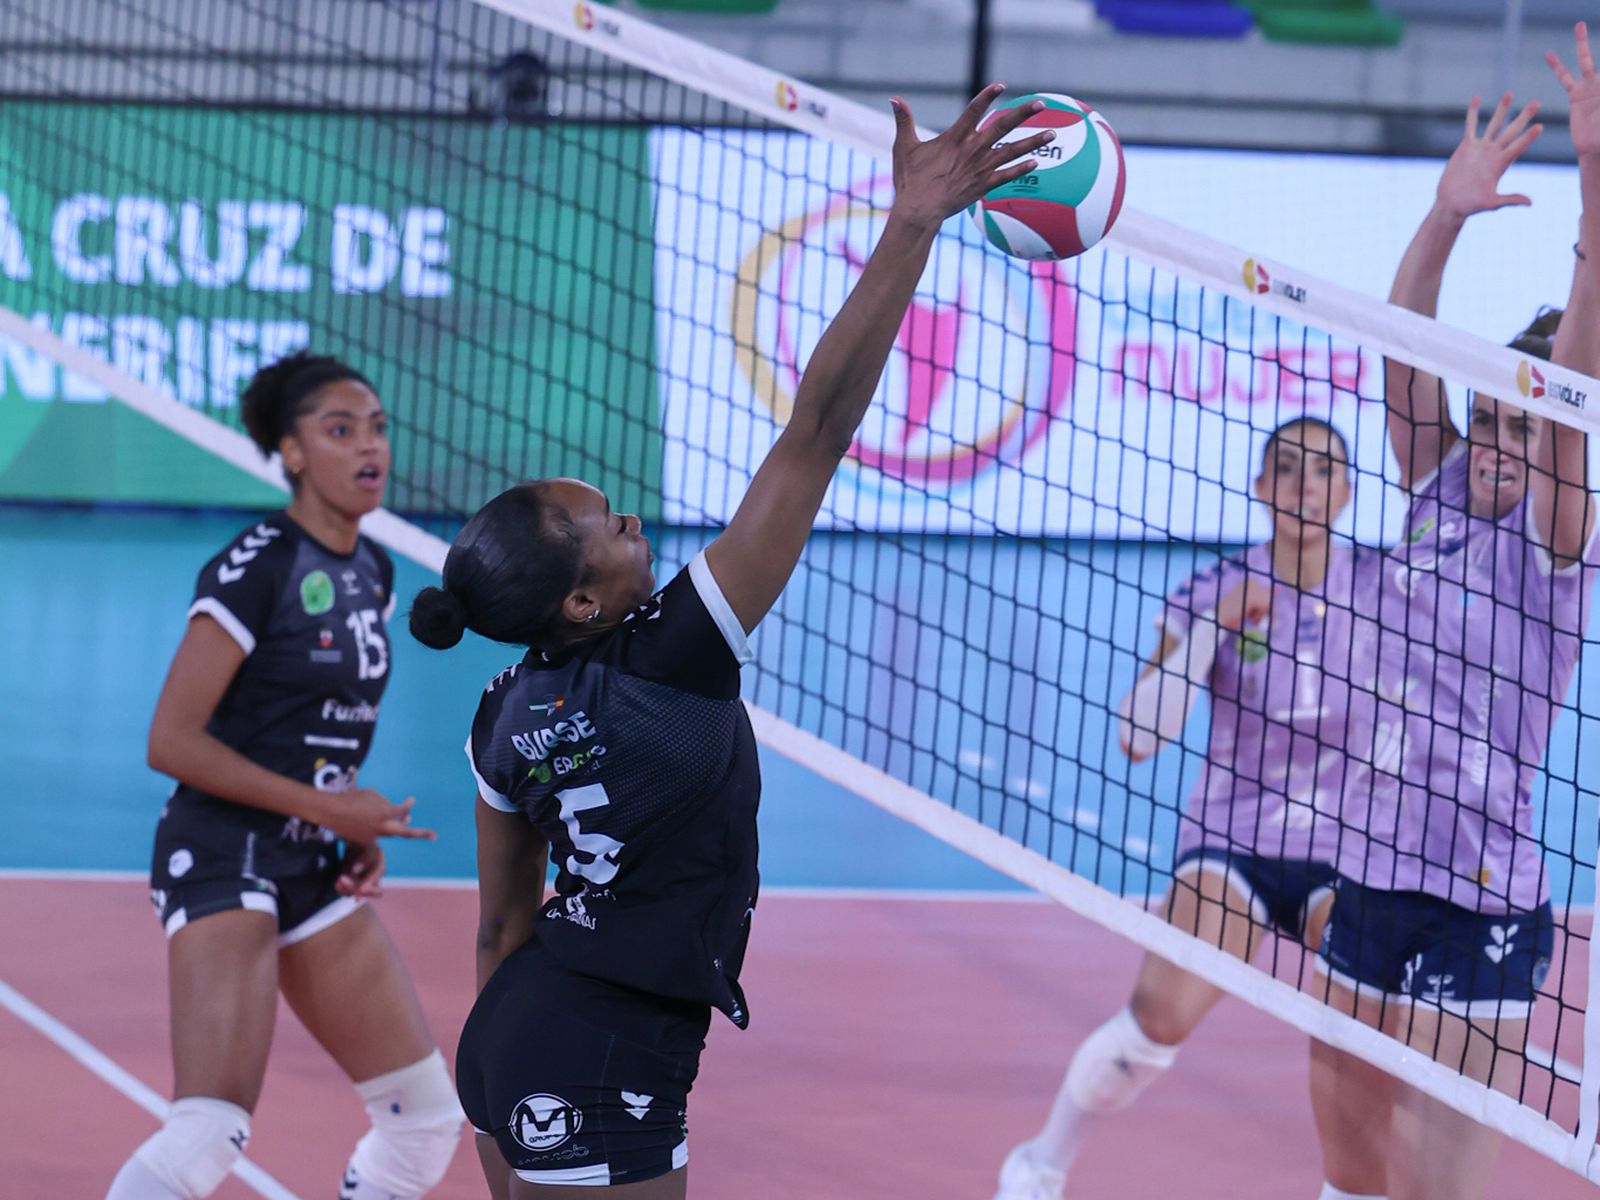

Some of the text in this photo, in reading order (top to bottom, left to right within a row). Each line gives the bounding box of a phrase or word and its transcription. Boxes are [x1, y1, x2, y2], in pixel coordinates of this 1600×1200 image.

[52, 192, 312, 293] CRUZ
[331, 203, 453, 298] DE
[1112, 345, 1367, 405] MUJER
[346, 608, 389, 681] 15
[554, 782, 626, 886] 5
